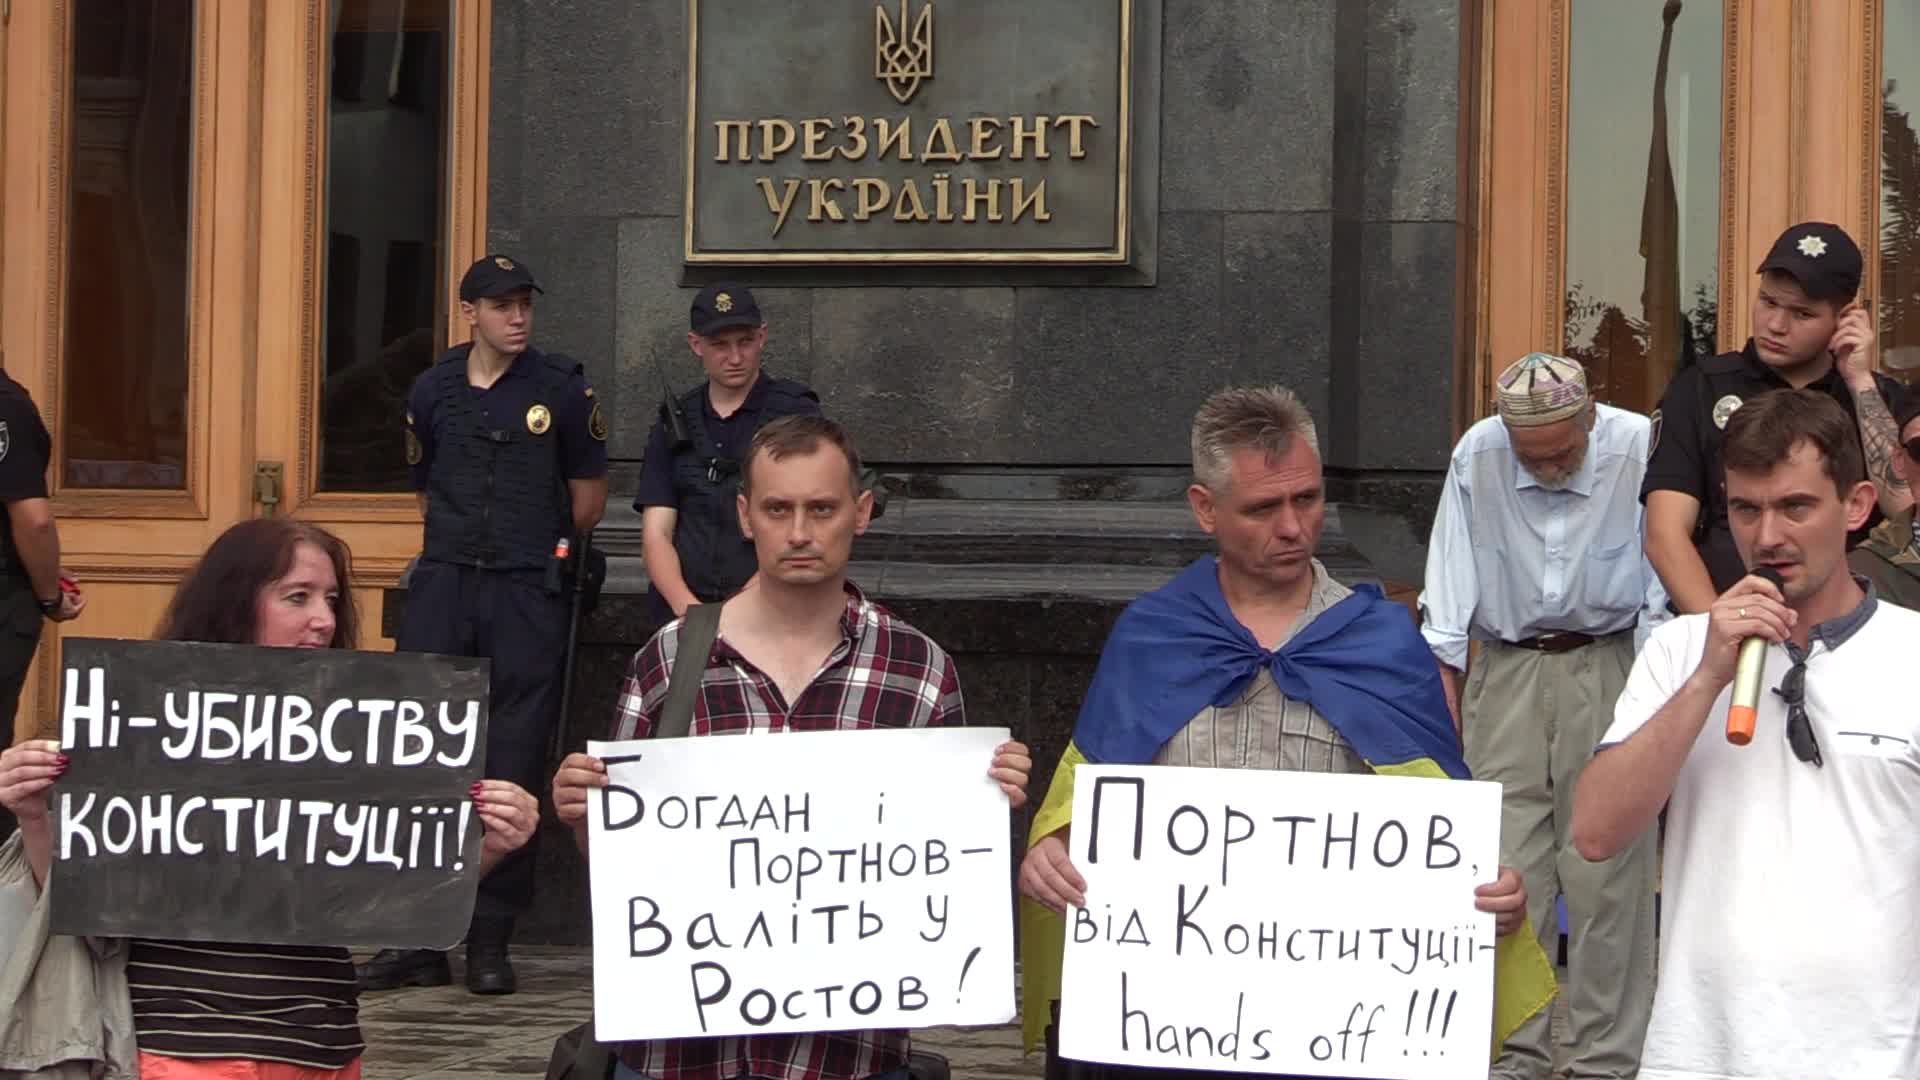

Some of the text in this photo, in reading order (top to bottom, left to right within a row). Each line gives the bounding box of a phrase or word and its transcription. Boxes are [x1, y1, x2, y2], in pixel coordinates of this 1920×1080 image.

[713, 114, 1099, 163] ПРЕЗИДЕНТ
[755, 172, 1051, 238] УКРАЇНИ
[877, 792, 885, 825] і
[1121, 971, 1273, 1061] hands
